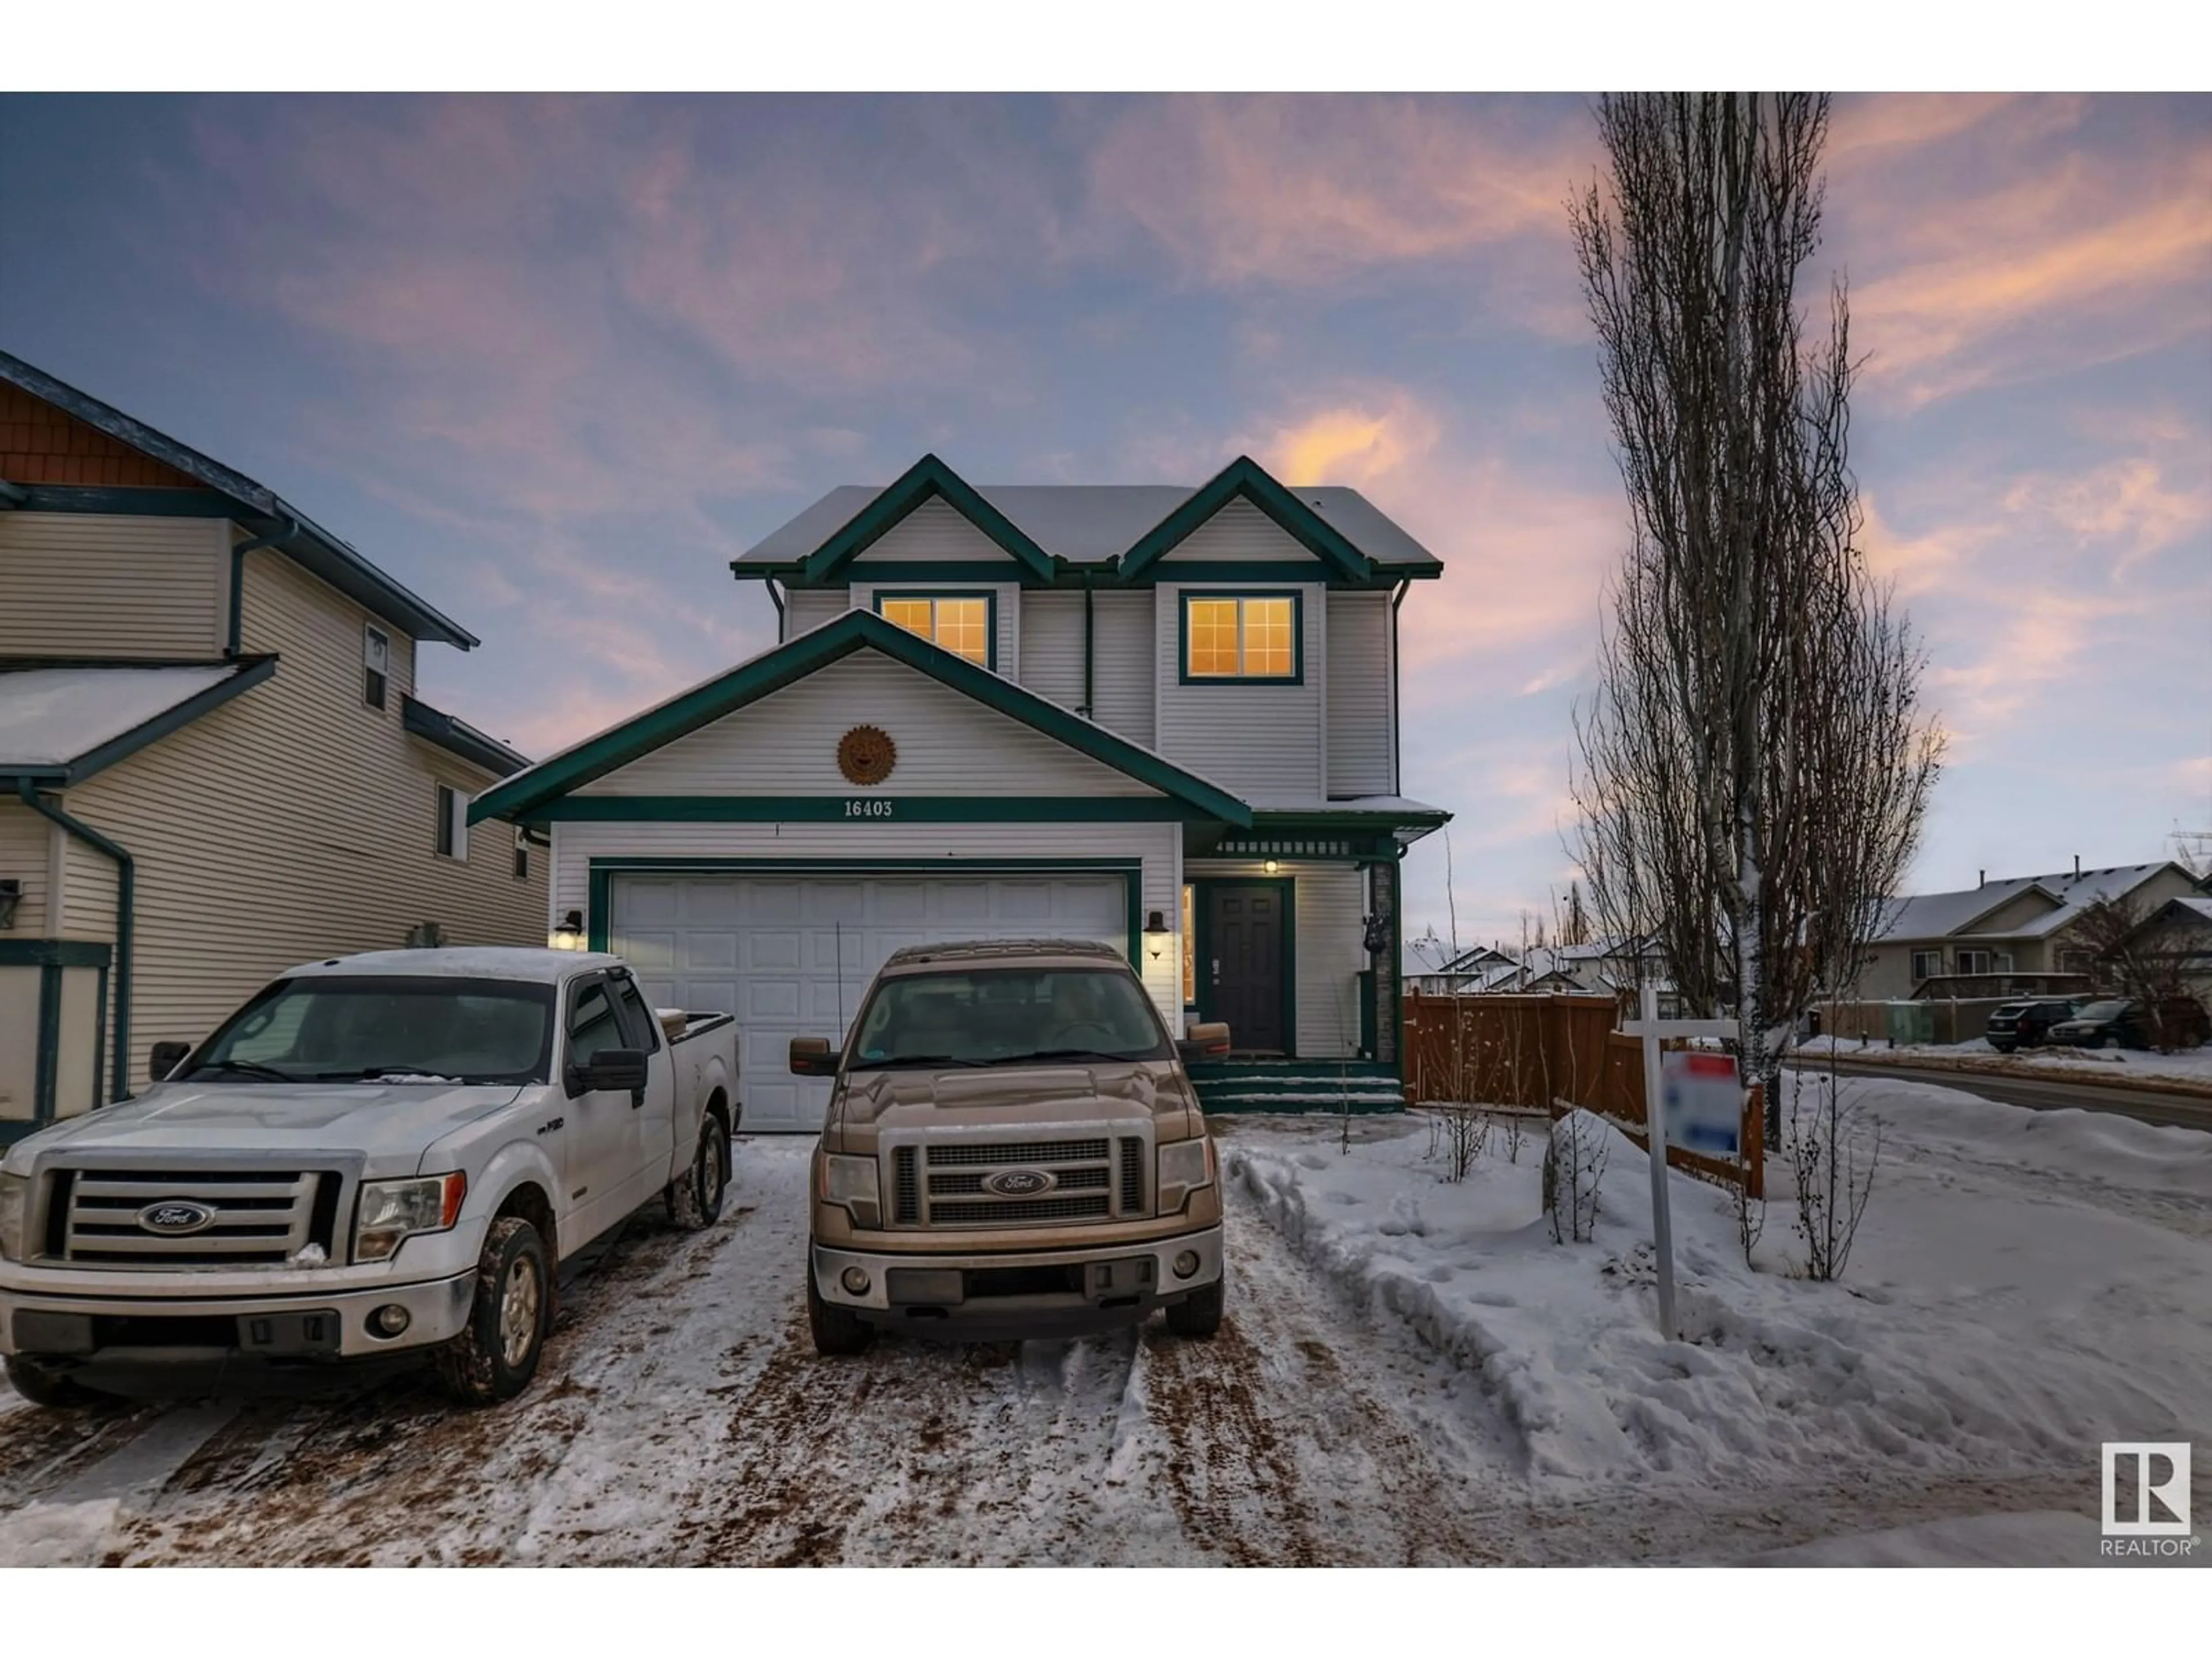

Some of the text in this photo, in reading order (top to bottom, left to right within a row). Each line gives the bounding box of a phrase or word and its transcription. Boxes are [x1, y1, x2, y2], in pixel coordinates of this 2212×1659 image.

[844, 800, 892, 816] 16403
[1005, 1176, 1034, 1188] Ford
[154, 1209, 191, 1224] Ford
